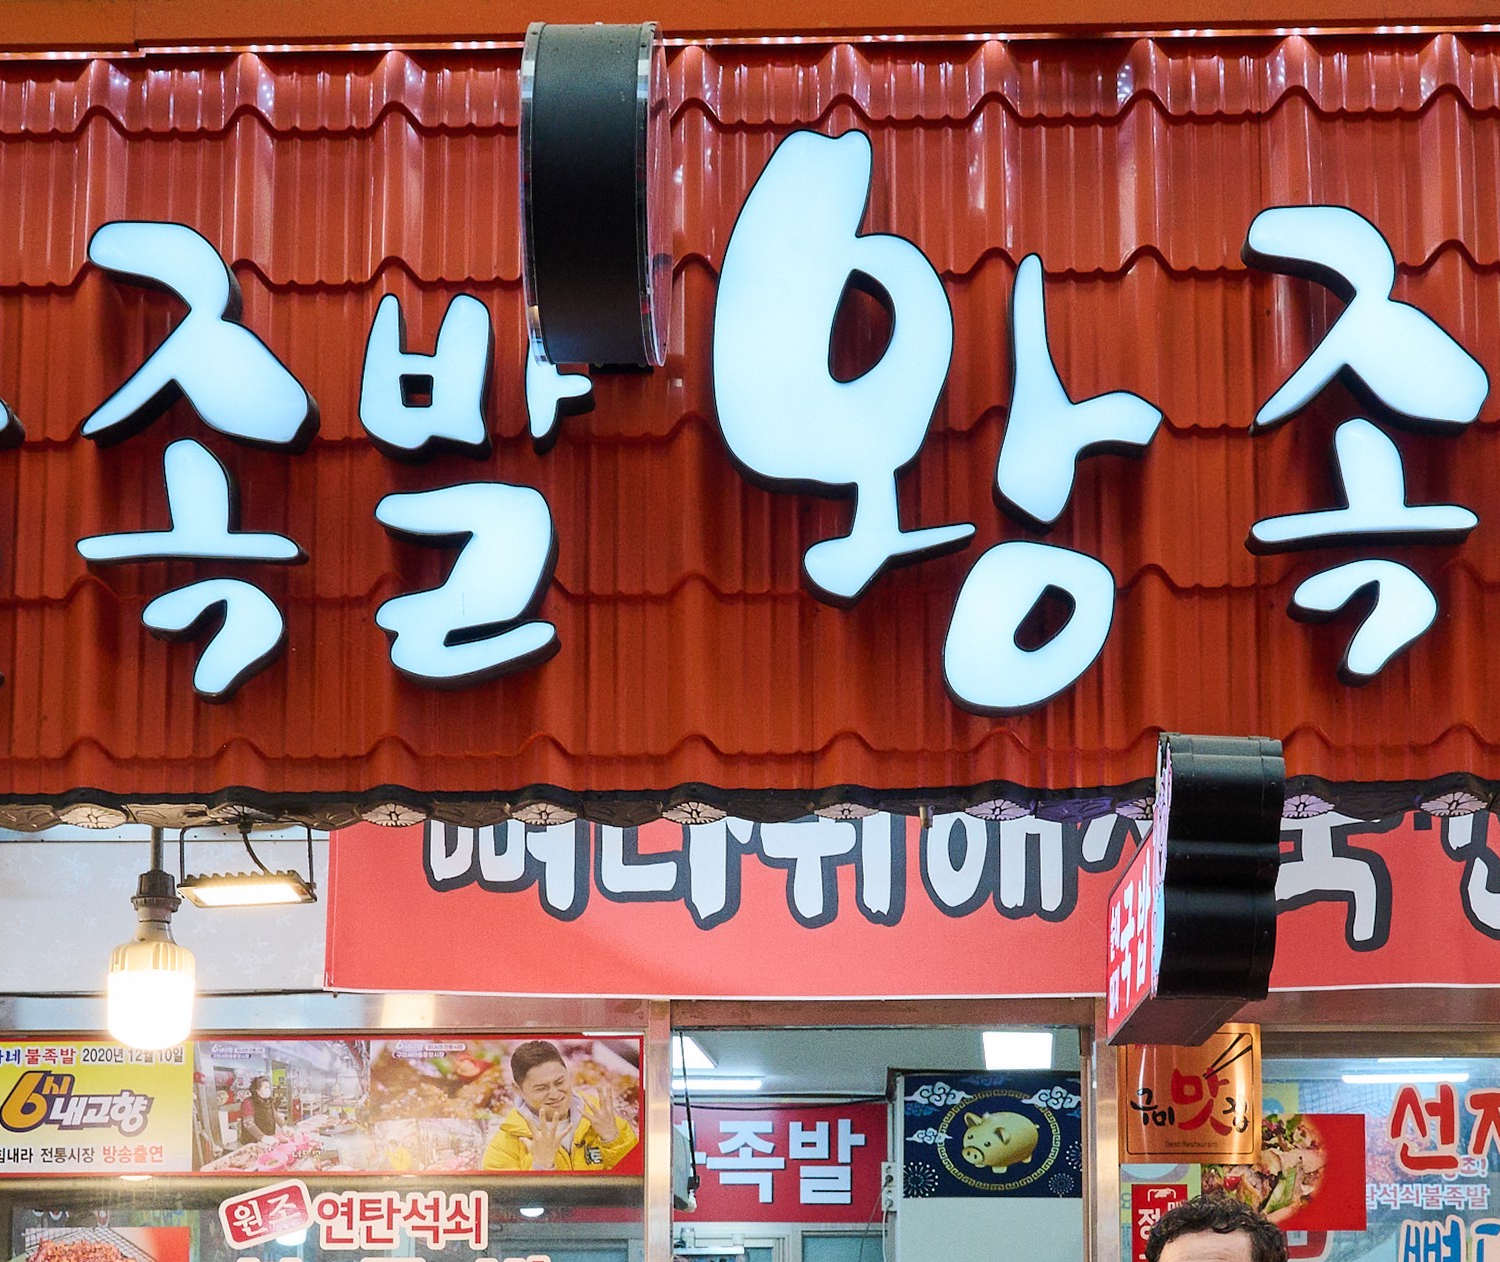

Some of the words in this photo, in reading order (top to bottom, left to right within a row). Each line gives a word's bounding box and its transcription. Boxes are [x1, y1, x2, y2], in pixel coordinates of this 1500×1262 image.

[25, 1048, 76, 1065] 불족발
[82, 1048, 124, 1063] 2020년
[158, 1048, 184, 1063] 10일
[49, 1091, 152, 1136] 내고향
[41, 1148, 96, 1164] 전통시장
[102, 1146, 164, 1164] 방송출연
[232, 1193, 301, 1237] 원조
[316, 1196, 483, 1245] 연탄석쇠
